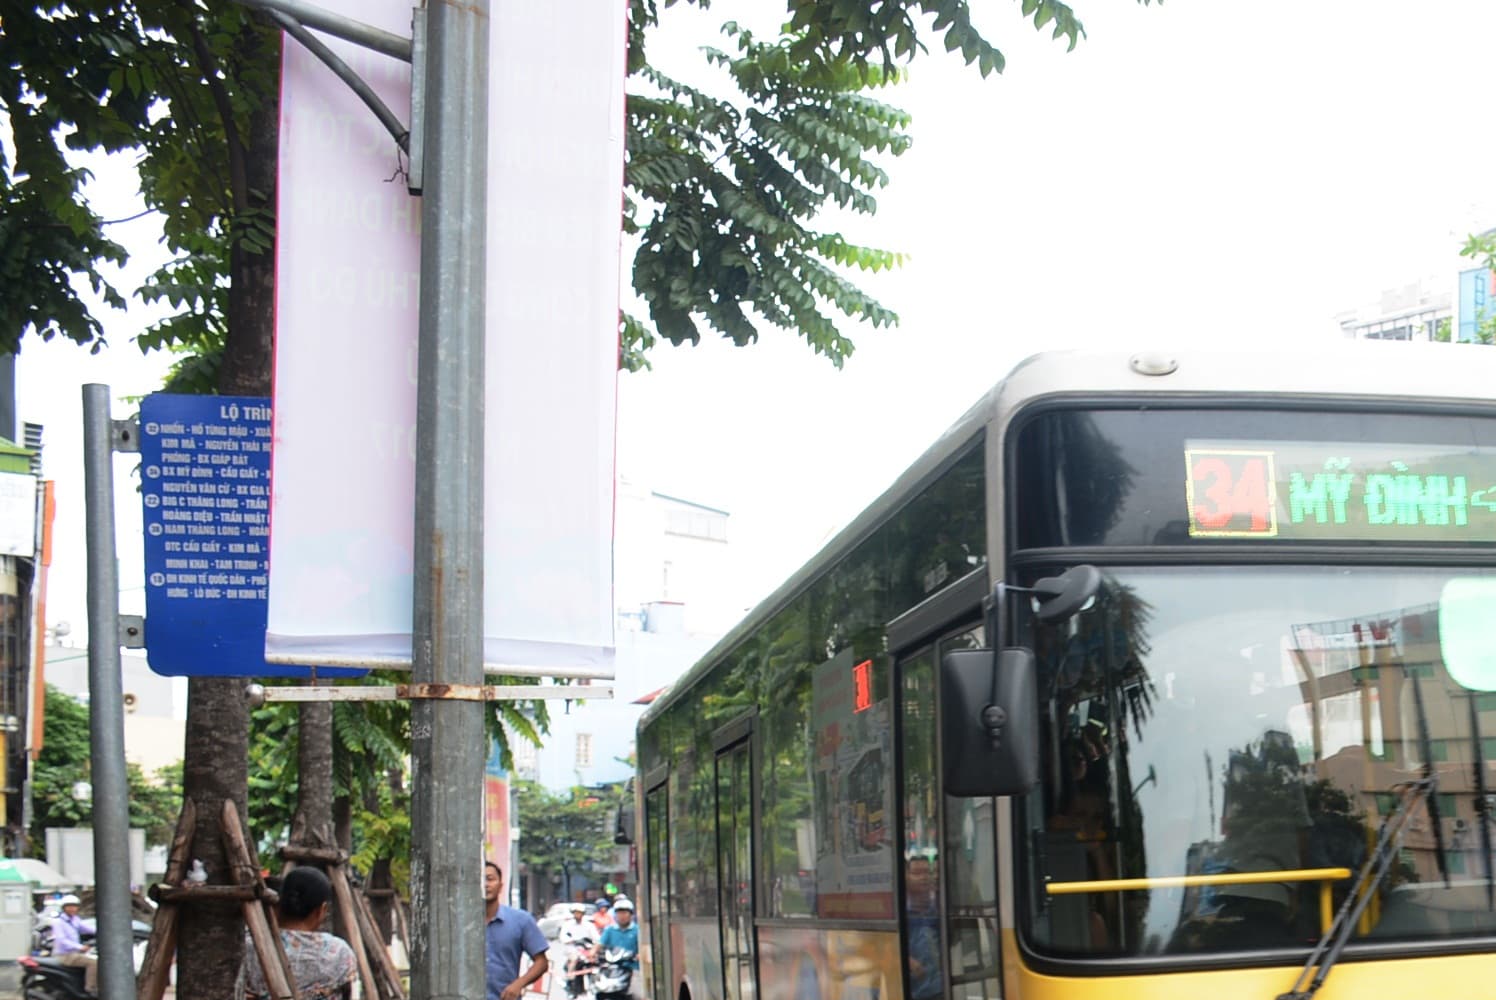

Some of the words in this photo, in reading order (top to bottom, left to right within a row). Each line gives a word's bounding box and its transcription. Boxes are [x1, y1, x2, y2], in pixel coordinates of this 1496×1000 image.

[221, 403, 239, 421] LỘ
[1192, 457, 1268, 532] 34
[1290, 456, 1354, 524] MỸ
[1365, 460, 1468, 526] ĐÌNH
